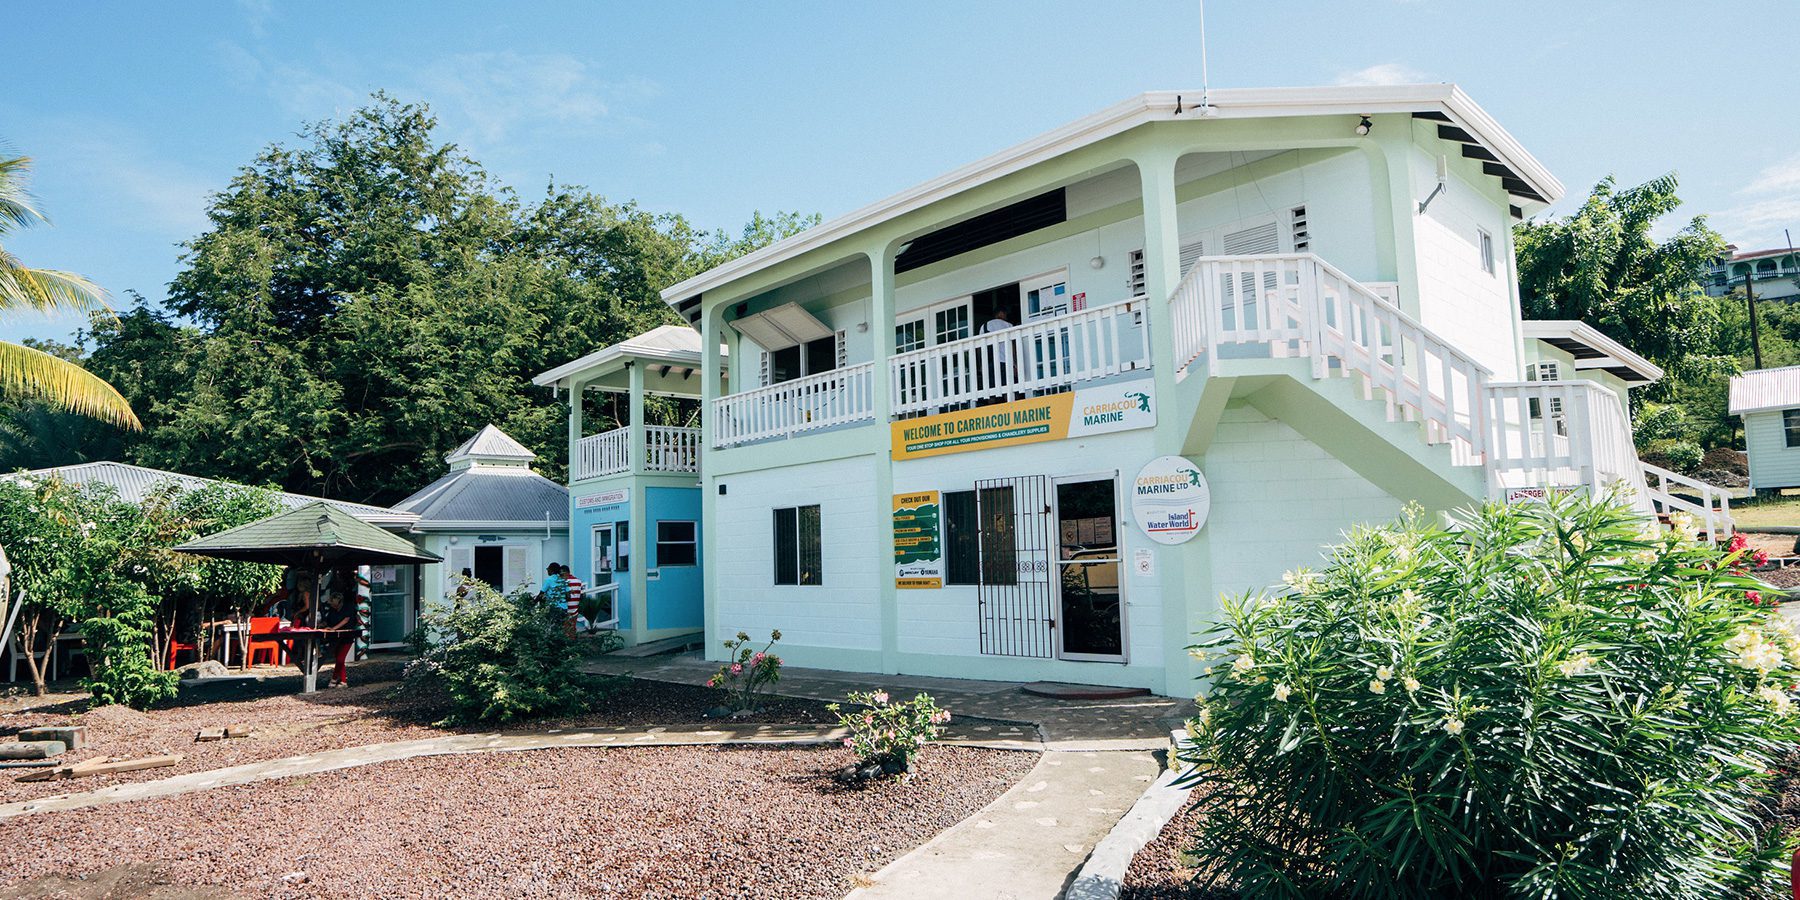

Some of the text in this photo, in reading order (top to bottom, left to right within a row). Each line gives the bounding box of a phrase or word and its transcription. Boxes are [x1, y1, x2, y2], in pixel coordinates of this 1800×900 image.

[1083, 400, 1137, 416] CARRIACOU
[904, 406, 1052, 441] WELCOME TO CARRIACOU MARINE
[1084, 411, 1124, 426] MARINE
[971, 434, 997, 442] PROVISIONING
[1002, 429, 1026, 438] CHANDLERY
[1027, 426, 1048, 434] SUPPLIES
[1137, 474, 1188, 486] CARRIACOU
[1137, 482, 1189, 495] MARINE LTD
[1168, 512, 1189, 521] Island
[1147, 520, 1189, 529] Water World
